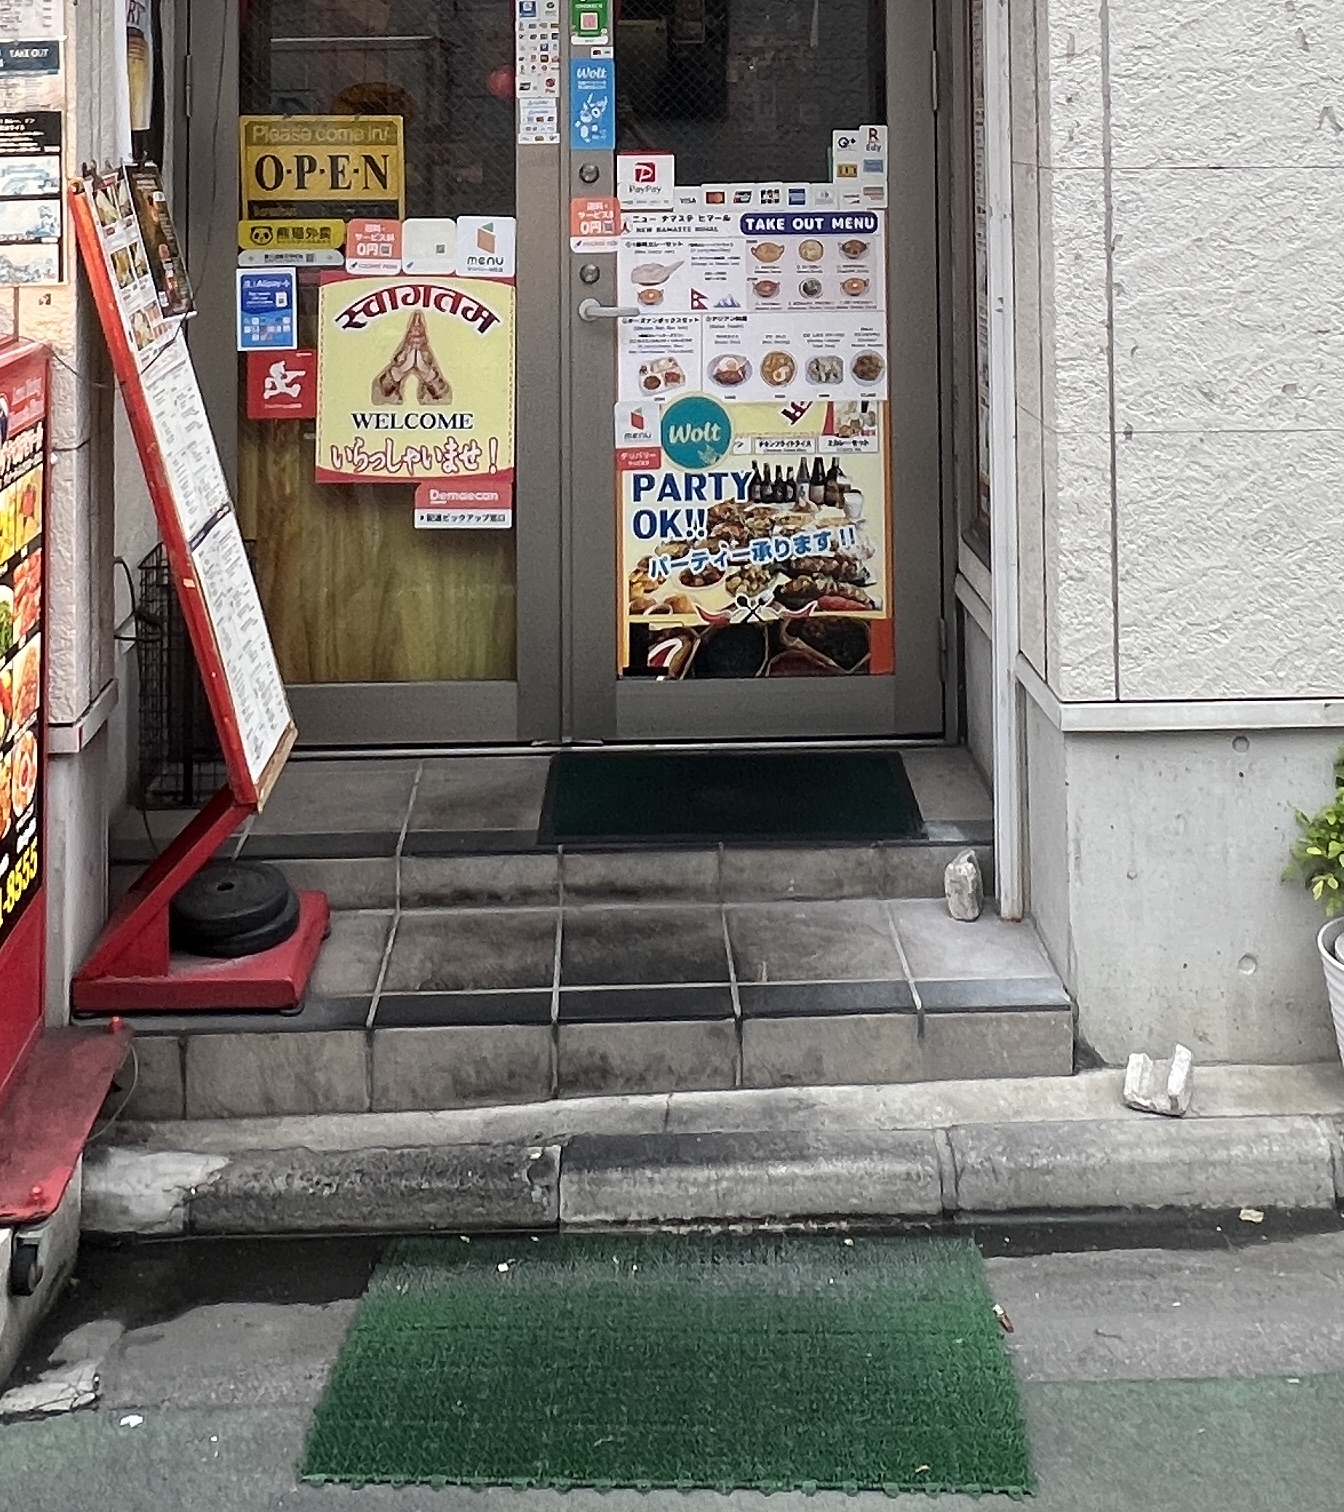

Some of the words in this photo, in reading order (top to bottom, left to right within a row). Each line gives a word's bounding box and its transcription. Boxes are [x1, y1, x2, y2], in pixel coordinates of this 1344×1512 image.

[577, 67, 607, 79] Wolt
[629, 185, 662, 194] PayPay
[745, 217, 785, 230] TAKE
[792, 217, 824, 230] OUT
[831, 216, 875, 230] MENU
[467, 256, 504, 266] menu
[352, 413, 474, 429] WELCOME
[669, 421, 721, 444] Wolt
[632, 471, 752, 502] PARTY
[632, 508, 706, 538] OK!!
